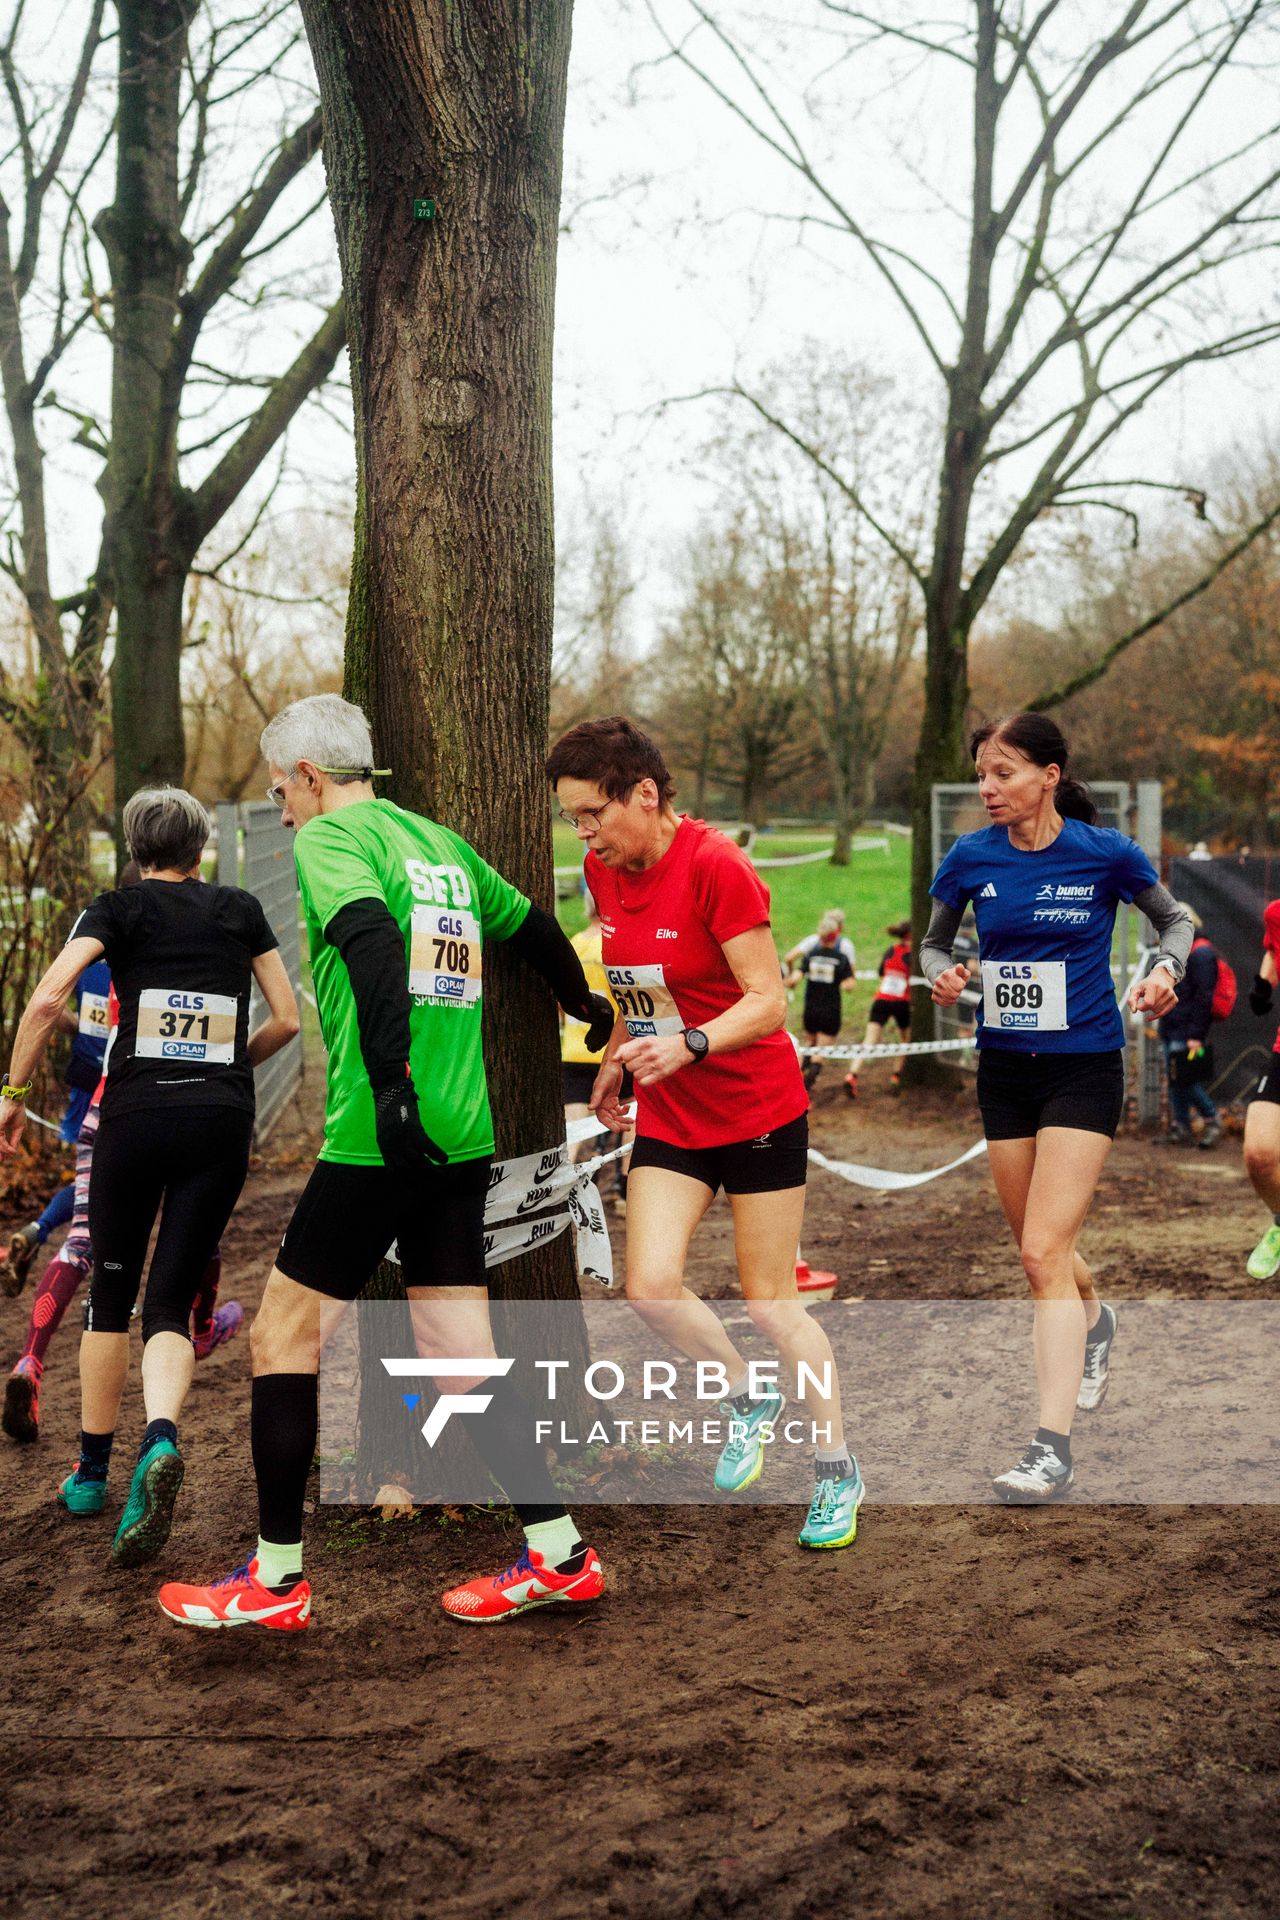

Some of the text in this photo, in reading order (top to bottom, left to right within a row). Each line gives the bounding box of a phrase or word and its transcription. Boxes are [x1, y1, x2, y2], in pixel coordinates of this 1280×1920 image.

[1056, 884, 1095, 896] bunert
[656, 928, 678, 939] Elke
[432, 938, 469, 974] 708
[449, 980, 464, 990] PLAN
[612, 989, 654, 1018] 610
[995, 983, 1043, 1009] 689
[158, 1011, 209, 1041] 371
[1014, 1015, 1036, 1023] PLAN
[635, 1023, 655, 1033] PLAN
[180, 1044, 204, 1054] PLAN
[540, 1151, 563, 1170] RUN
[531, 1220, 555, 1241] RUN
